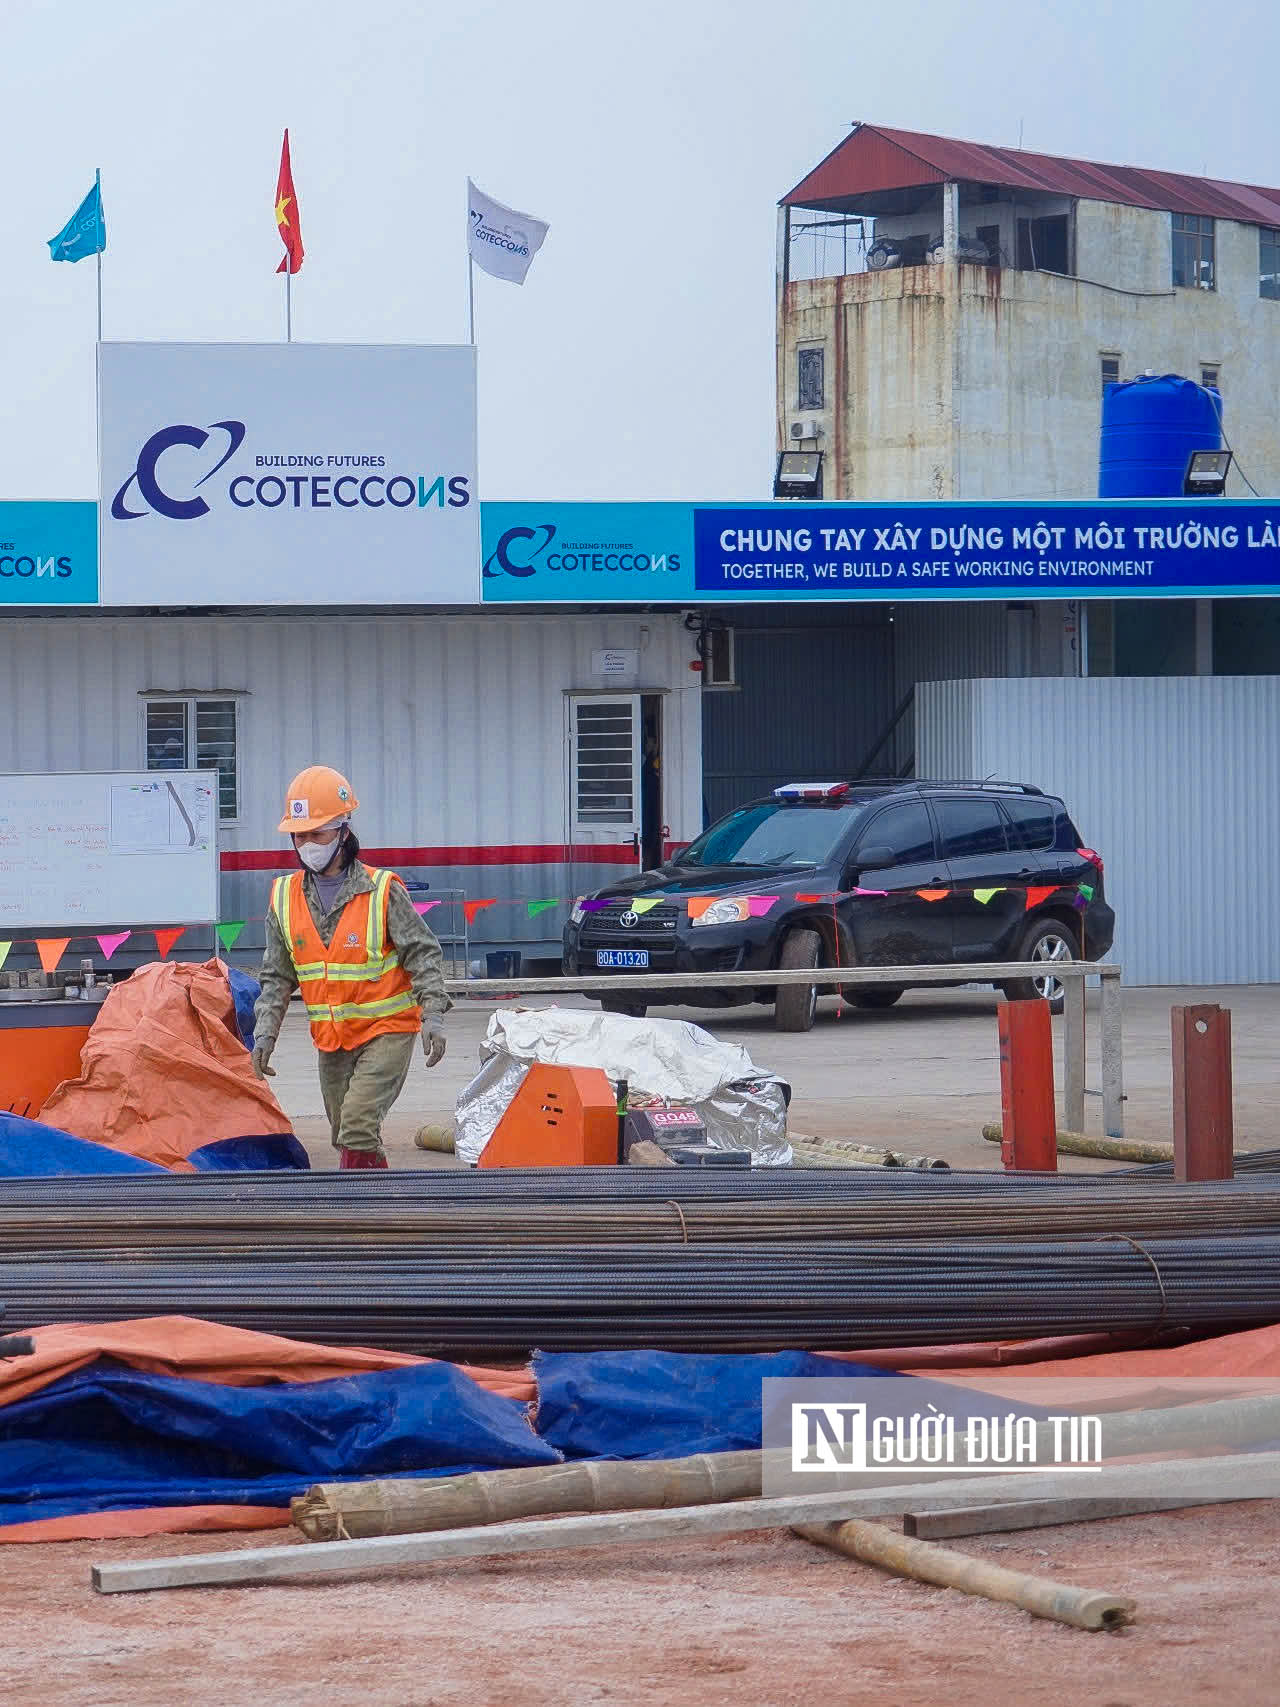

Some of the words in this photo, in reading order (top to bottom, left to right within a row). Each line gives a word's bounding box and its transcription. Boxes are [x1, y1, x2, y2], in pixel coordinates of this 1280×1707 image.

[255, 455, 324, 467] BUILDING
[327, 455, 386, 467] FUTURES
[720, 529, 812, 551] CHUNG
[820, 528, 866, 550] TAY
[873, 522, 922, 550] XÂY
[930, 523, 1004, 556] DỰNG
[1012, 521, 1066, 556] MỘT
[1074, 521, 1126, 549] MÔI
[1134, 519, 1239, 549] TRƯỜNG
[561, 542, 600, 550] BUILDING
[601, 542, 633, 550] FUTURES
[721, 563, 809, 581] TOGETHER,
[813, 563, 838, 578] WE
[842, 562, 893, 578] BUILD
[896, 562, 908, 577] A
[911, 561, 951, 577] SAFE
[954, 561, 1034, 577] WORKING
[1039, 560, 1154, 576] ENVIRONMENT
